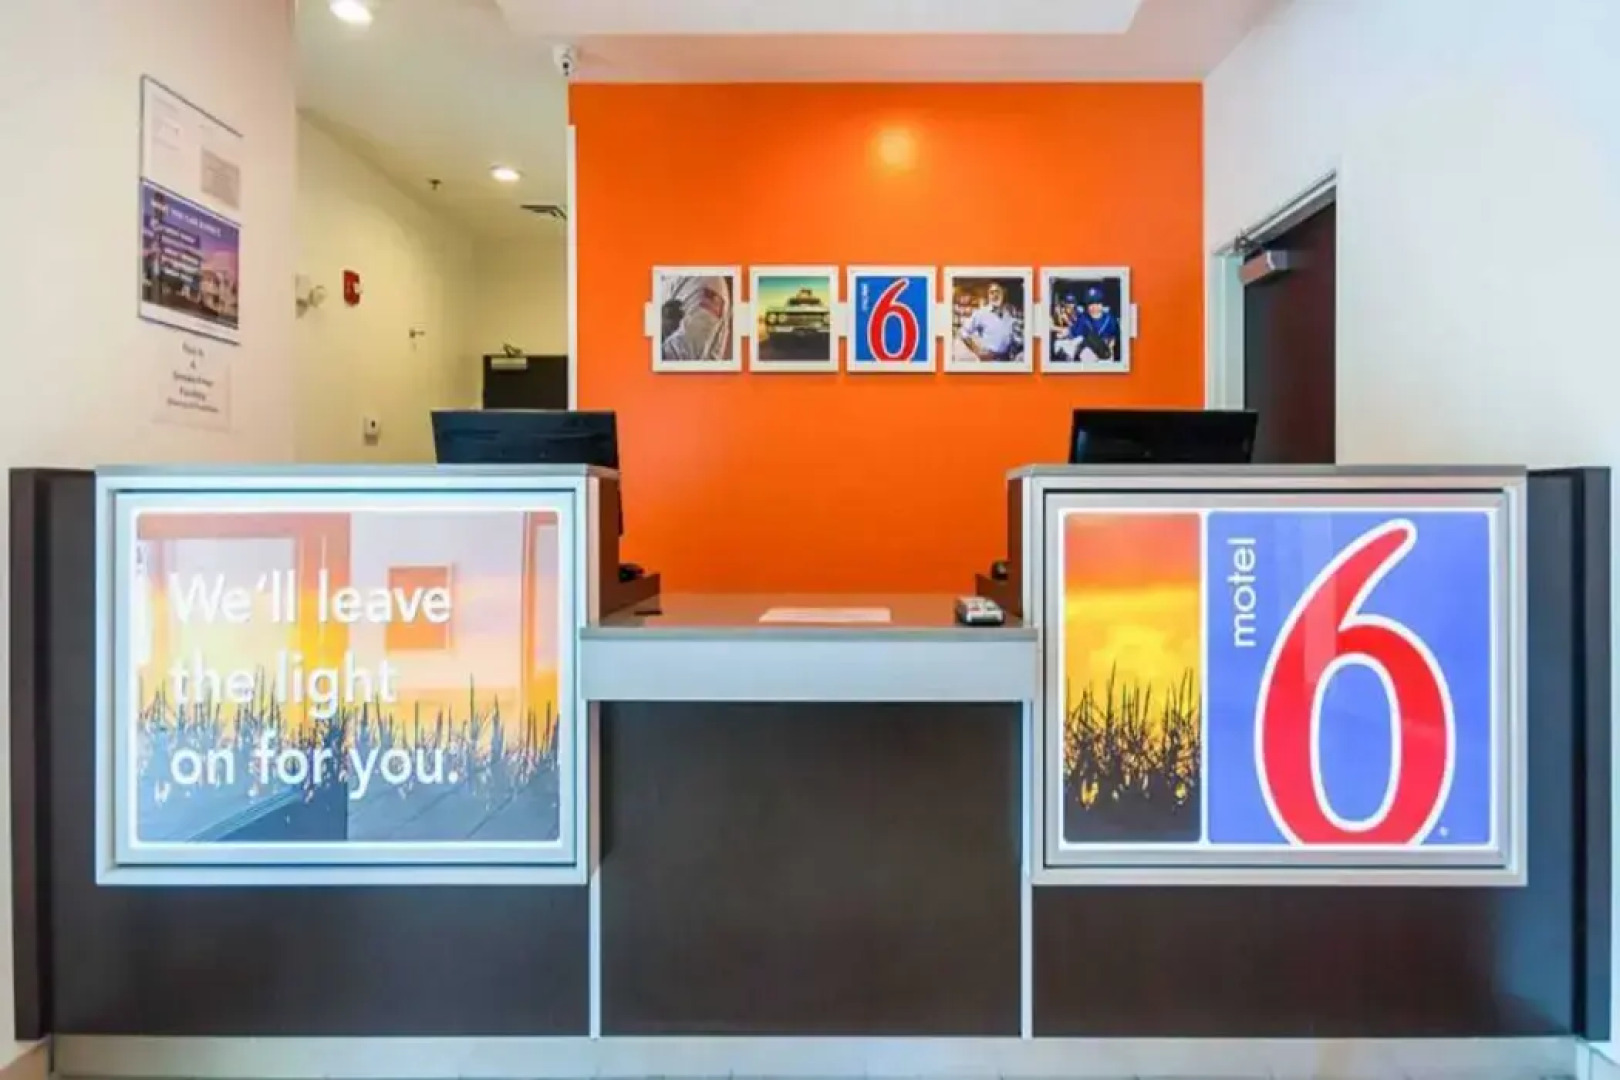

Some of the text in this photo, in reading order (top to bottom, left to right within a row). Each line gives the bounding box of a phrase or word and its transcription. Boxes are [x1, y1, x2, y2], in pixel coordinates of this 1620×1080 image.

[867, 278, 919, 363] 6
[169, 569, 452, 623] We'll leave
[171, 649, 397, 718] the light
[1227, 518, 1456, 845] motel 6
[171, 730, 459, 799] on for you.
